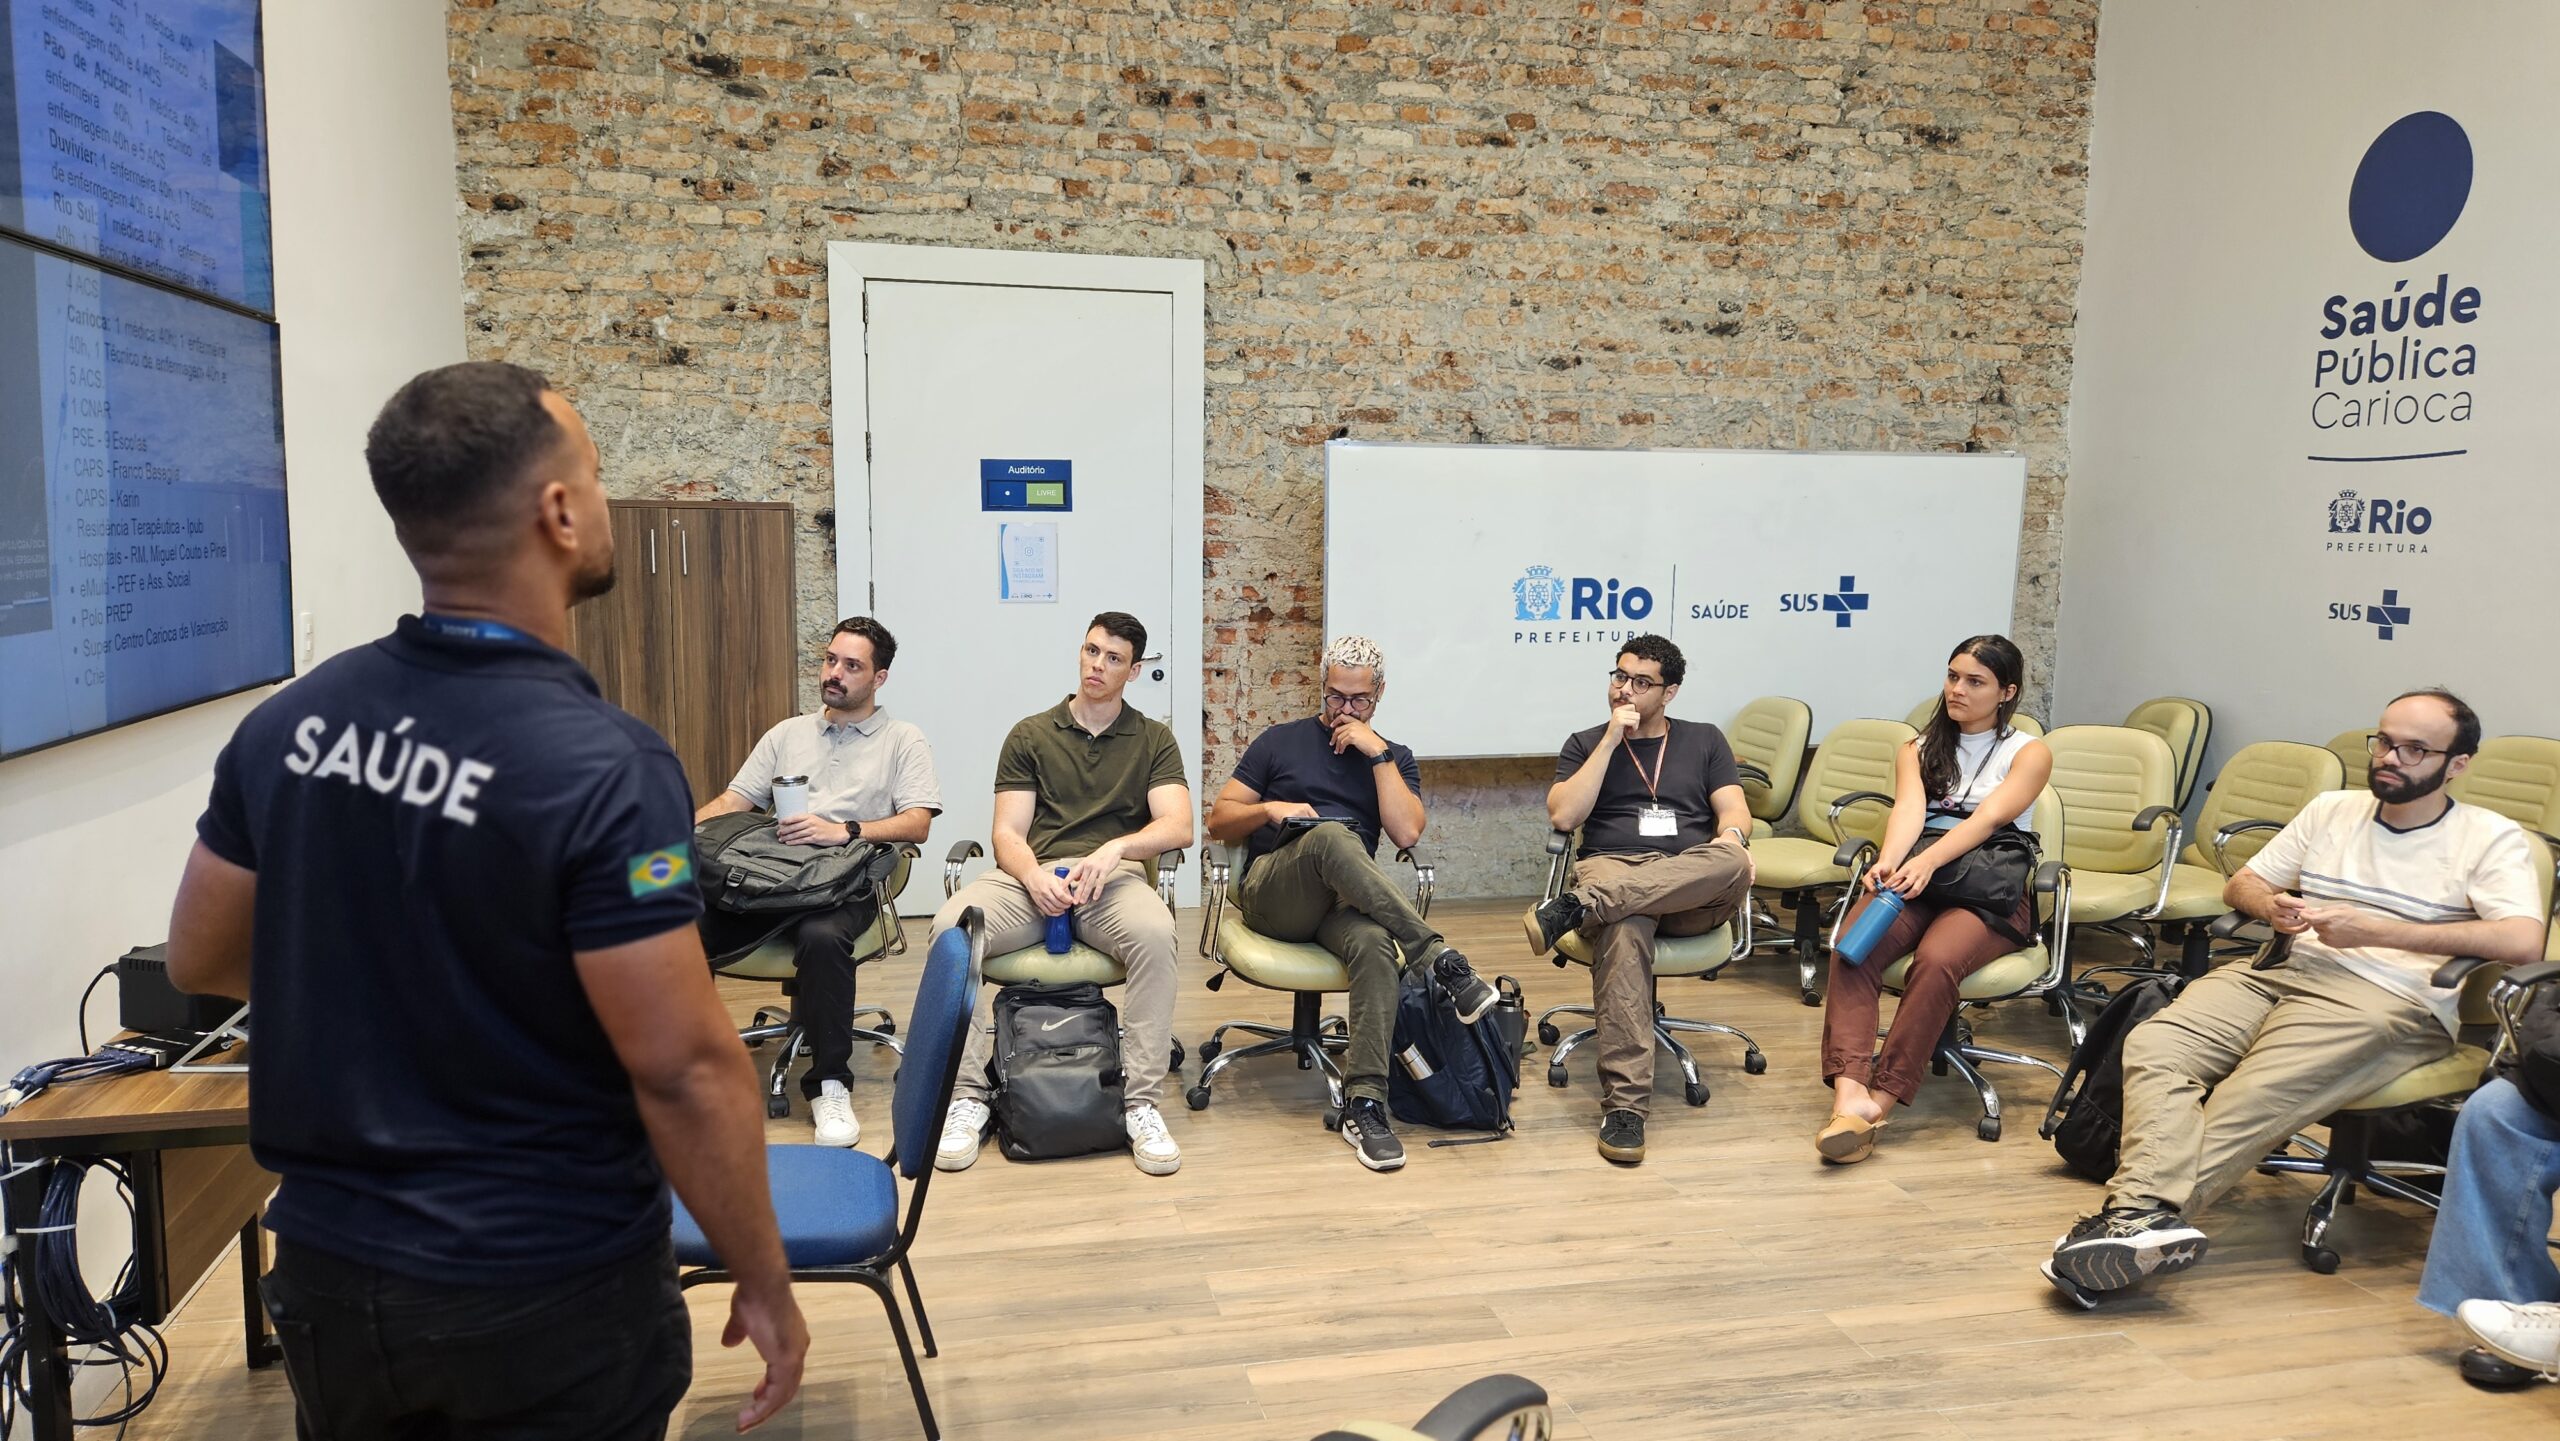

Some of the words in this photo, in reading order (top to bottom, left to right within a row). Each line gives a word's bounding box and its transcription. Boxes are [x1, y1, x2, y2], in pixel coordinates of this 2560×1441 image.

[42, 5, 105, 52] enfermagem
[142, 62, 162, 88] ACS
[43, 31, 66, 60] Pão
[73, 52, 87, 72] de
[94, 61, 132, 98] Açúcar:
[45, 69, 100, 109] enfermeira
[161, 126, 193, 158] Técnico
[47, 101, 111, 142] enfermagem
[112, 129, 130, 154] 40h
[146, 147, 166, 171] ACS
[49, 127, 98, 167] Duvivier:
[110, 160, 156, 193] enfermeira
[184, 190, 214, 220] Técnico
[51, 160, 65, 183] de
[67, 171, 128, 208] enfermagem
[155, 204, 161, 223] 4
[163, 207, 181, 231] ACS
[53, 191, 73, 217] Rio
[77, 201, 98, 226] Sul:
[112, 218, 145, 243] médica
[66, 272, 73, 289] 4
[2320, 273, 2481, 340] Saúde
[67, 304, 111, 332] Carioca:
[124, 321, 156, 343] médica
[187, 335, 227, 359] enfermeira
[69, 365, 77, 385] 5
[104, 342, 140, 366] Técnico
[156, 356, 205, 382] enfermagem
[2315, 336, 2476, 388] Pública
[2312, 390, 2472, 429] Carioca
[72, 427, 95, 448] PSE
[112, 430, 148, 453] Escolas
[74, 458, 104, 478] CAPS
[112, 460, 143, 480] Franco
[1008, 465, 1046, 475] Auditório
[116, 489, 141, 508] Karin
[1036, 489, 1057, 497] LIVRE
[77, 518, 129, 538] Residência
[131, 517, 180, 539] Terapêutica
[2368, 499, 2432, 535] Rio
[79, 547, 122, 570] Hospitais
[150, 543, 178, 567] Miguel
[179, 544, 201, 561] Couto
[2326, 542, 2429, 554] PREFEITURA
[117, 574, 137, 593] PEF
[139, 577, 145, 591] e
[146, 573, 164, 591] Ass.
[167, 570, 191, 589] Social
[1571, 577, 1653, 620] Rio
[1691, 599, 1750, 619] SAÚDE
[1779, 593, 1818, 612] SUS
[2328, 602, 2361, 620] SUS
[81, 608, 103, 628] Polo
[106, 603, 133, 624] PREP
[83, 638, 112, 659] Super
[114, 633, 144, 651] Centro
[145, 627, 177, 646] Carioca
[179, 622, 189, 639] de
[190, 617, 229, 637] Vacinação
[84, 668, 105, 687] Crie
[284, 716, 494, 826] SAÚDE
